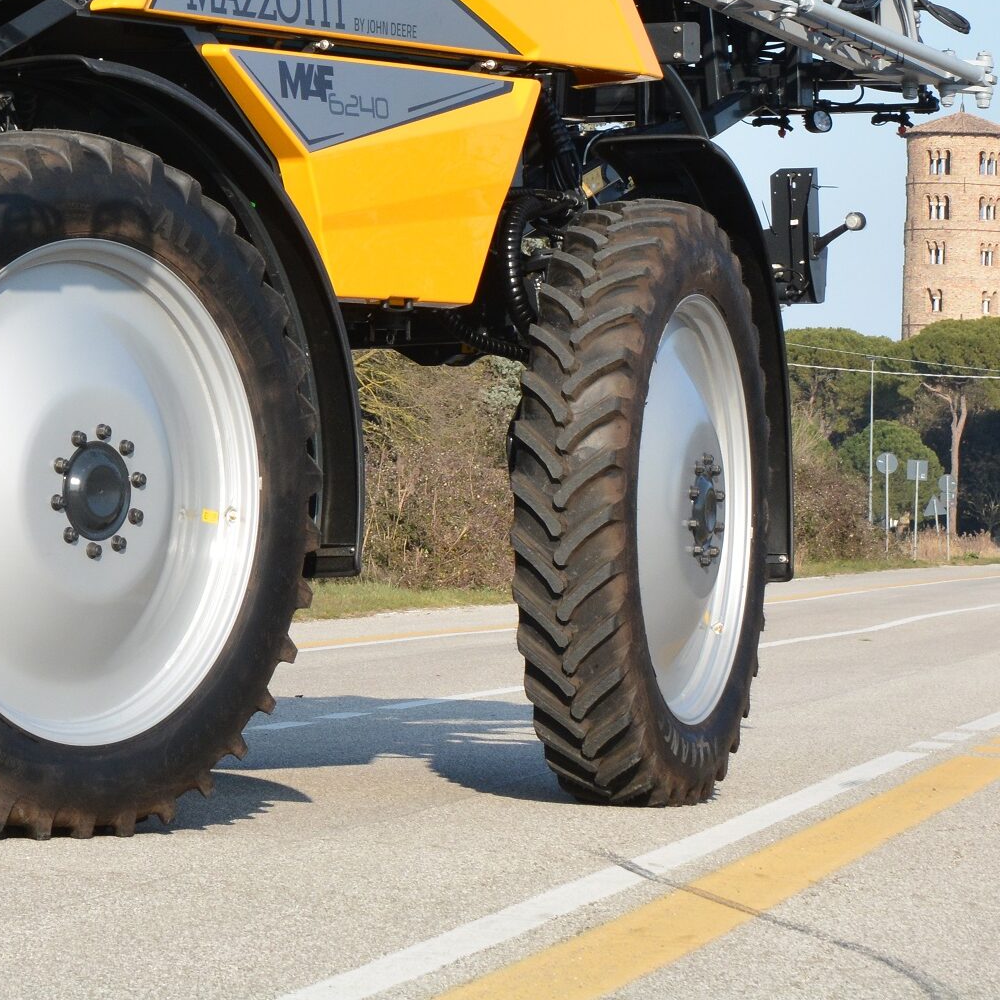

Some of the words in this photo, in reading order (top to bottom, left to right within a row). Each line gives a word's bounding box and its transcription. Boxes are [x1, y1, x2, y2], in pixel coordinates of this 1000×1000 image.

[354, 17, 366, 32] BY
[366, 19, 389, 36] JOHN
[390, 22, 418, 39] DEERE
[278, 60, 334, 103] MAF
[328, 92, 389, 119] 6240
